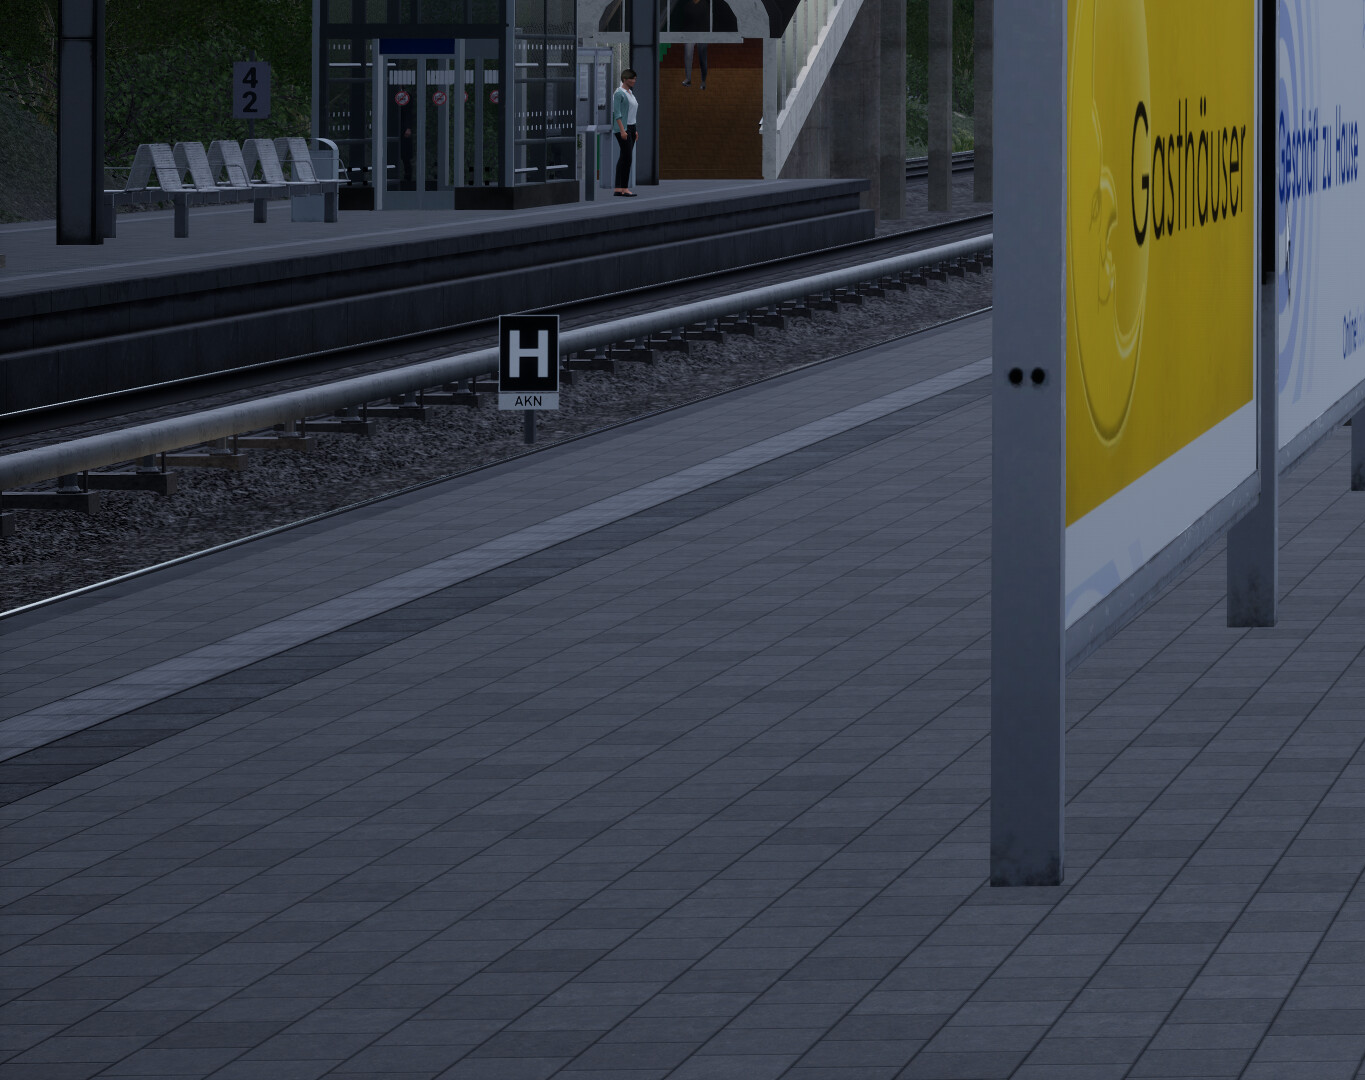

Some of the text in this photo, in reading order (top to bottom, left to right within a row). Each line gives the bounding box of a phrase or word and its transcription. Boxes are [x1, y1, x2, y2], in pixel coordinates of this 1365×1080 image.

[242, 67, 258, 89] 4
[242, 90, 258, 113] 2
[1131, 96, 1246, 247] Gasthäuser
[1278, 104, 1359, 204] Geschäft zu Hause
[508, 329, 549, 378] H
[514, 395, 543, 407] AKN
